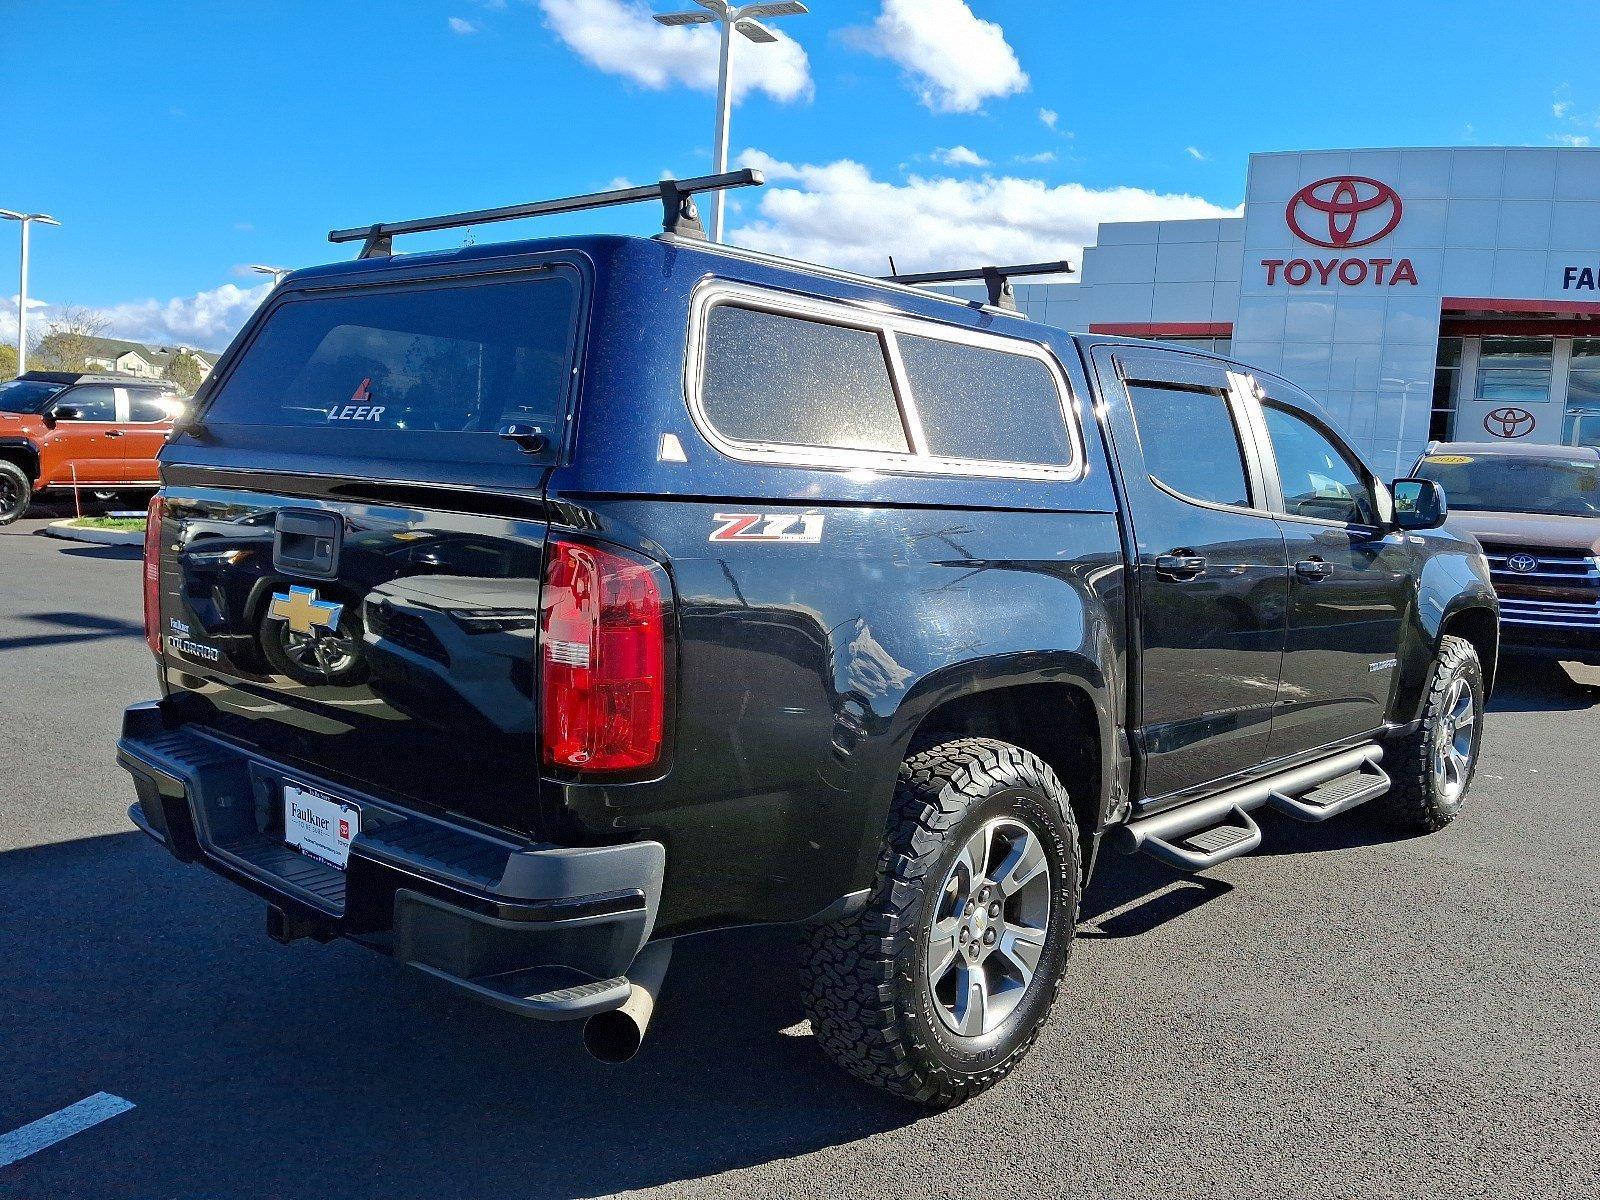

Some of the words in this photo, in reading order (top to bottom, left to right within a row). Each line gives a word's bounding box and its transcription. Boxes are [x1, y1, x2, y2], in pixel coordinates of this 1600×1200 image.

[1261, 258, 1418, 286] TOYOTA
[1562, 266, 1600, 290] FA
[327, 405, 385, 421] LEER
[709, 512, 825, 543] Z71
[168, 635, 219, 662] COLORADO
[291, 802, 330, 830] Faulkner
